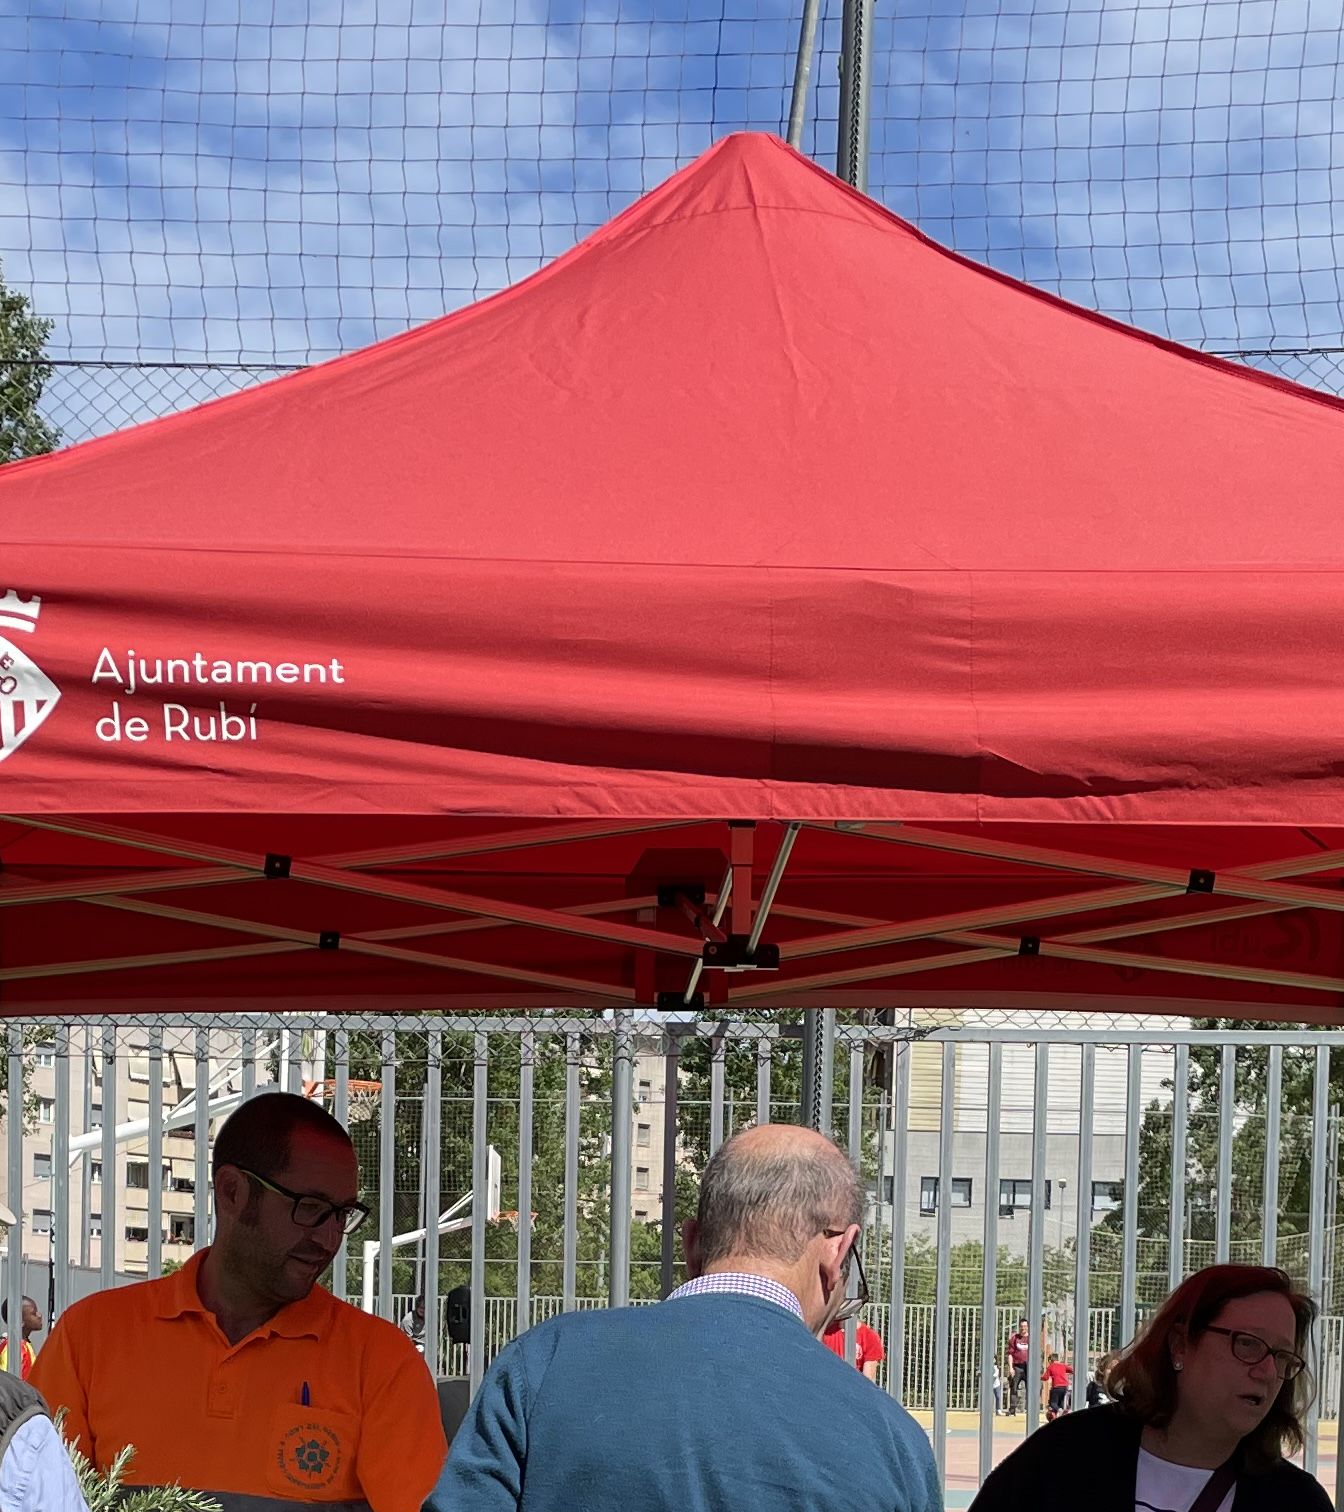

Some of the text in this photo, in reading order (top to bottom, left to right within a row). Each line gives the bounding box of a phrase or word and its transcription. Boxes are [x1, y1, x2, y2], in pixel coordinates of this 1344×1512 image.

[91, 646, 346, 694] Ajuntament
[96, 701, 258, 742] de Rubí
